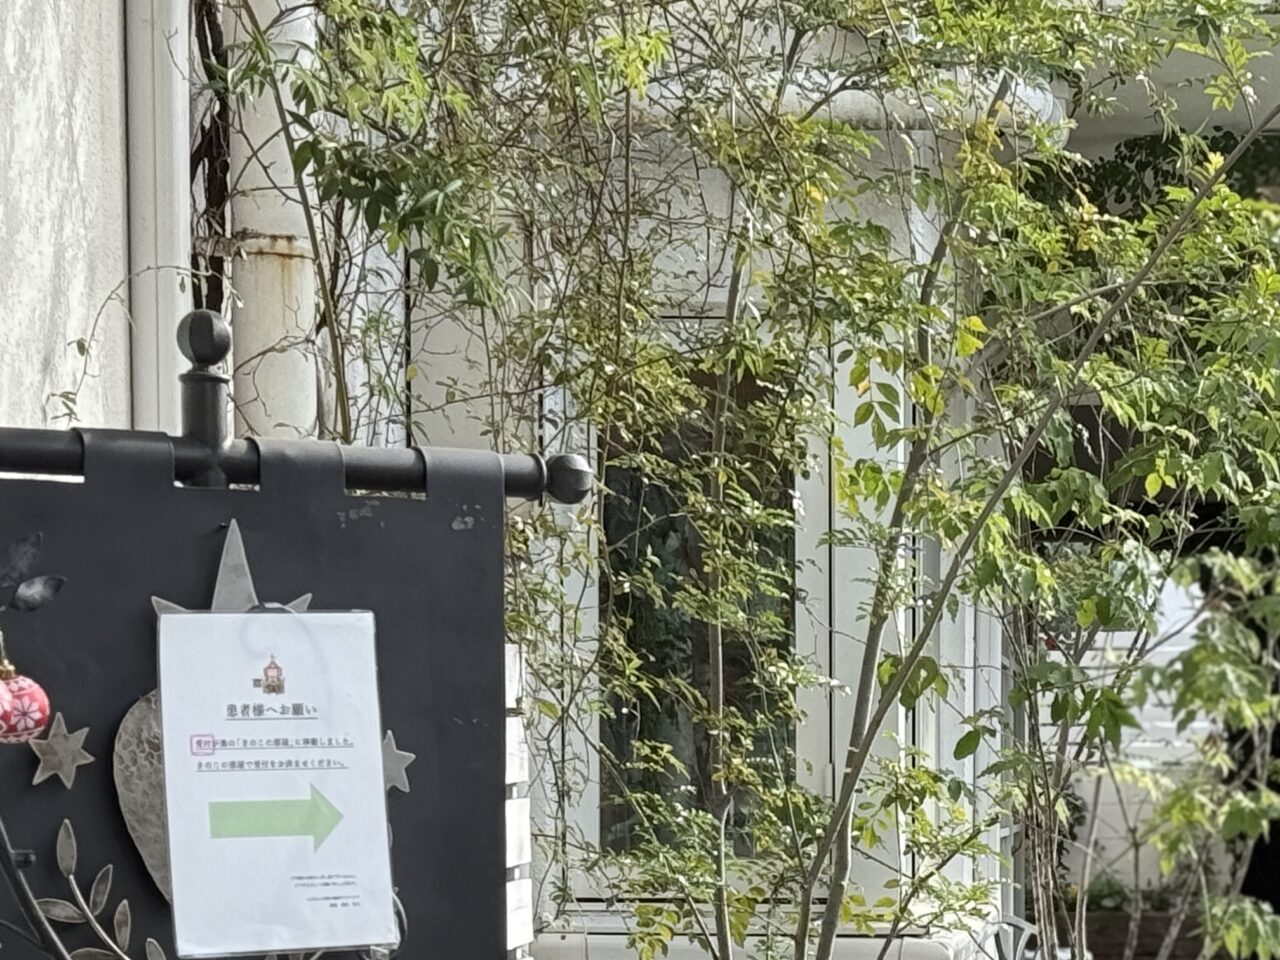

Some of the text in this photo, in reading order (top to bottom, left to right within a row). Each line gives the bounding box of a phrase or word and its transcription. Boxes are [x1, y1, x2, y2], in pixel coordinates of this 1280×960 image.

[226, 703, 318, 717] 患者様へお願い
